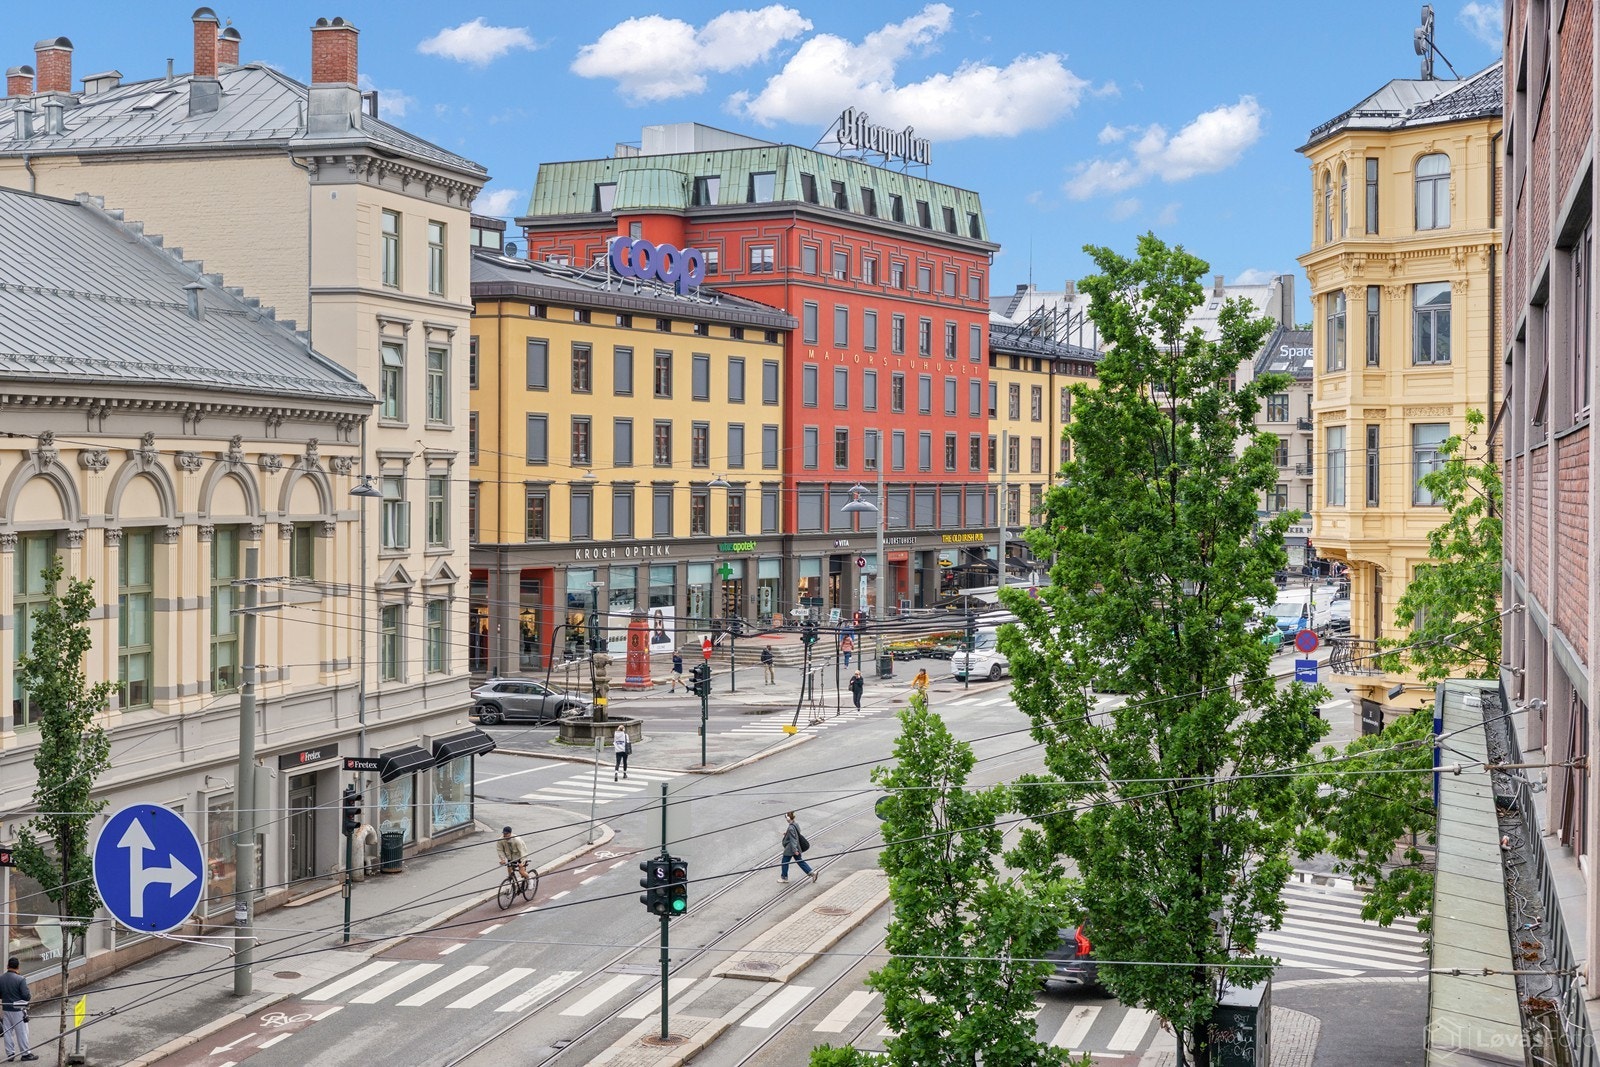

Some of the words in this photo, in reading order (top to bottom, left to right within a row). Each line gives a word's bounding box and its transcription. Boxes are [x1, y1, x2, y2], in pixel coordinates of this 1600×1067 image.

[1280, 344, 1314, 360] Spare
[808, 349, 979, 375] MAJORSTUHUSET
[575, 547, 616, 560] KROGH
[625, 545, 670, 557] OPTIKK
[304, 750, 321, 762] Fretex
[354, 762, 378, 770] Fretex
